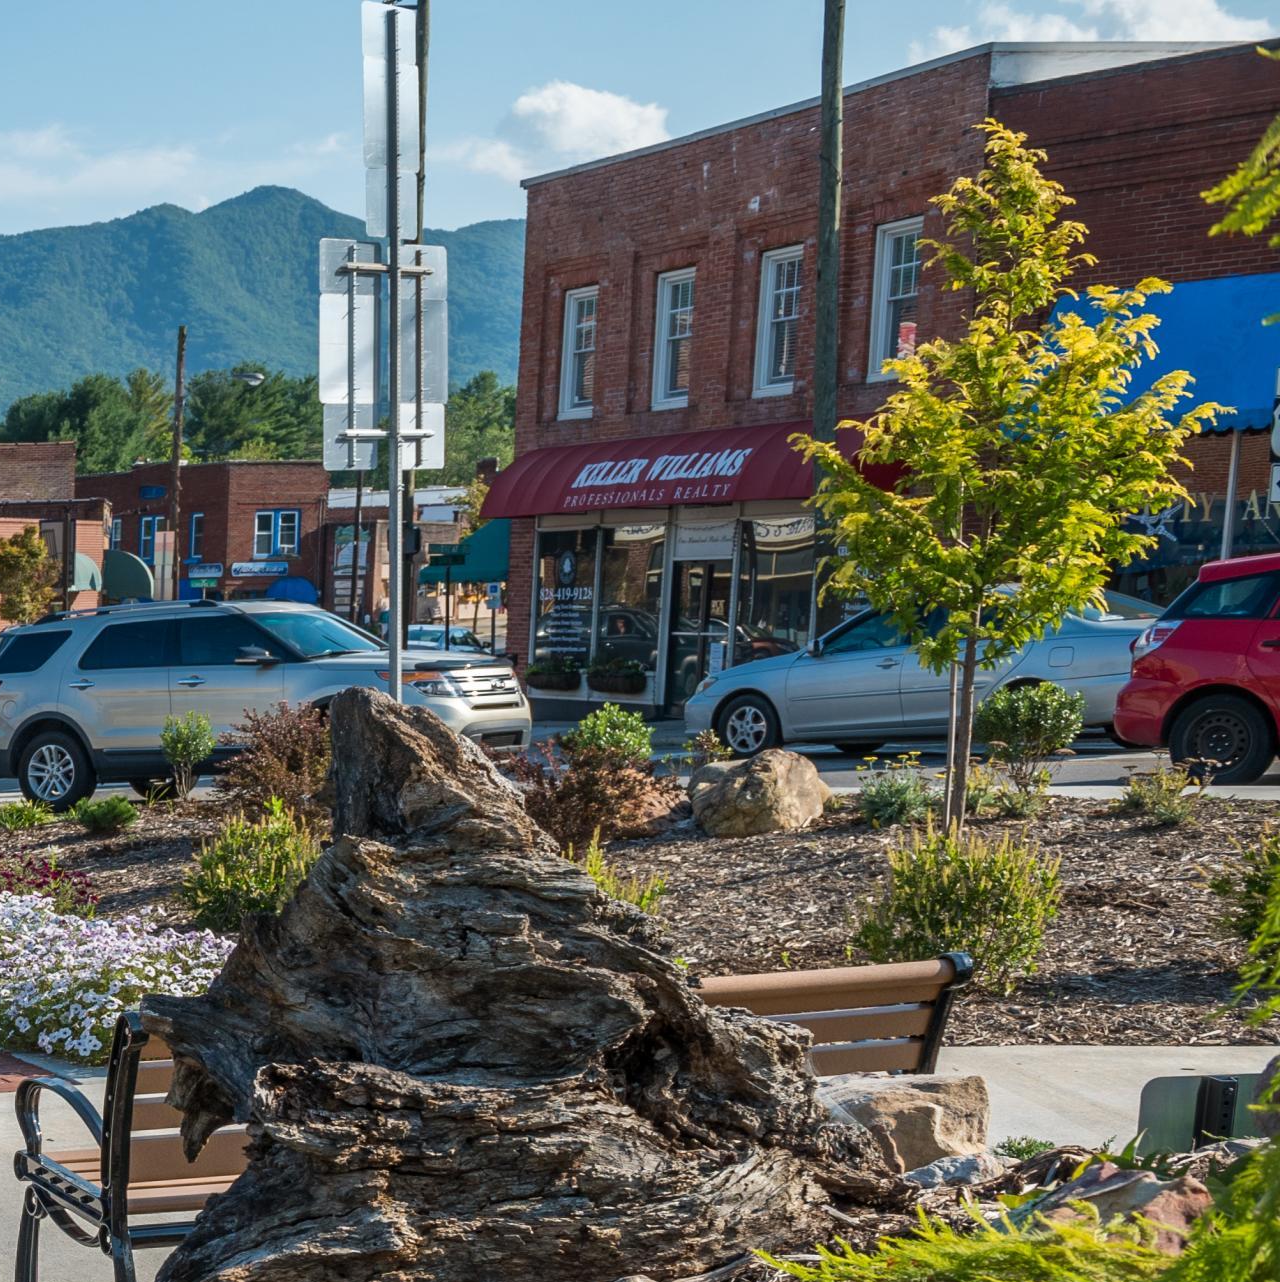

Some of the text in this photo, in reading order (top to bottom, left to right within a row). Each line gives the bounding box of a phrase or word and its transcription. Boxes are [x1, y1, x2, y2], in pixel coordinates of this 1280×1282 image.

[571, 447, 753, 489] KELLER WILLIAMS
[563, 482, 731, 508] PROFESSIONALS REALTY
[540, 586, 593, 601] 828-419-9128
